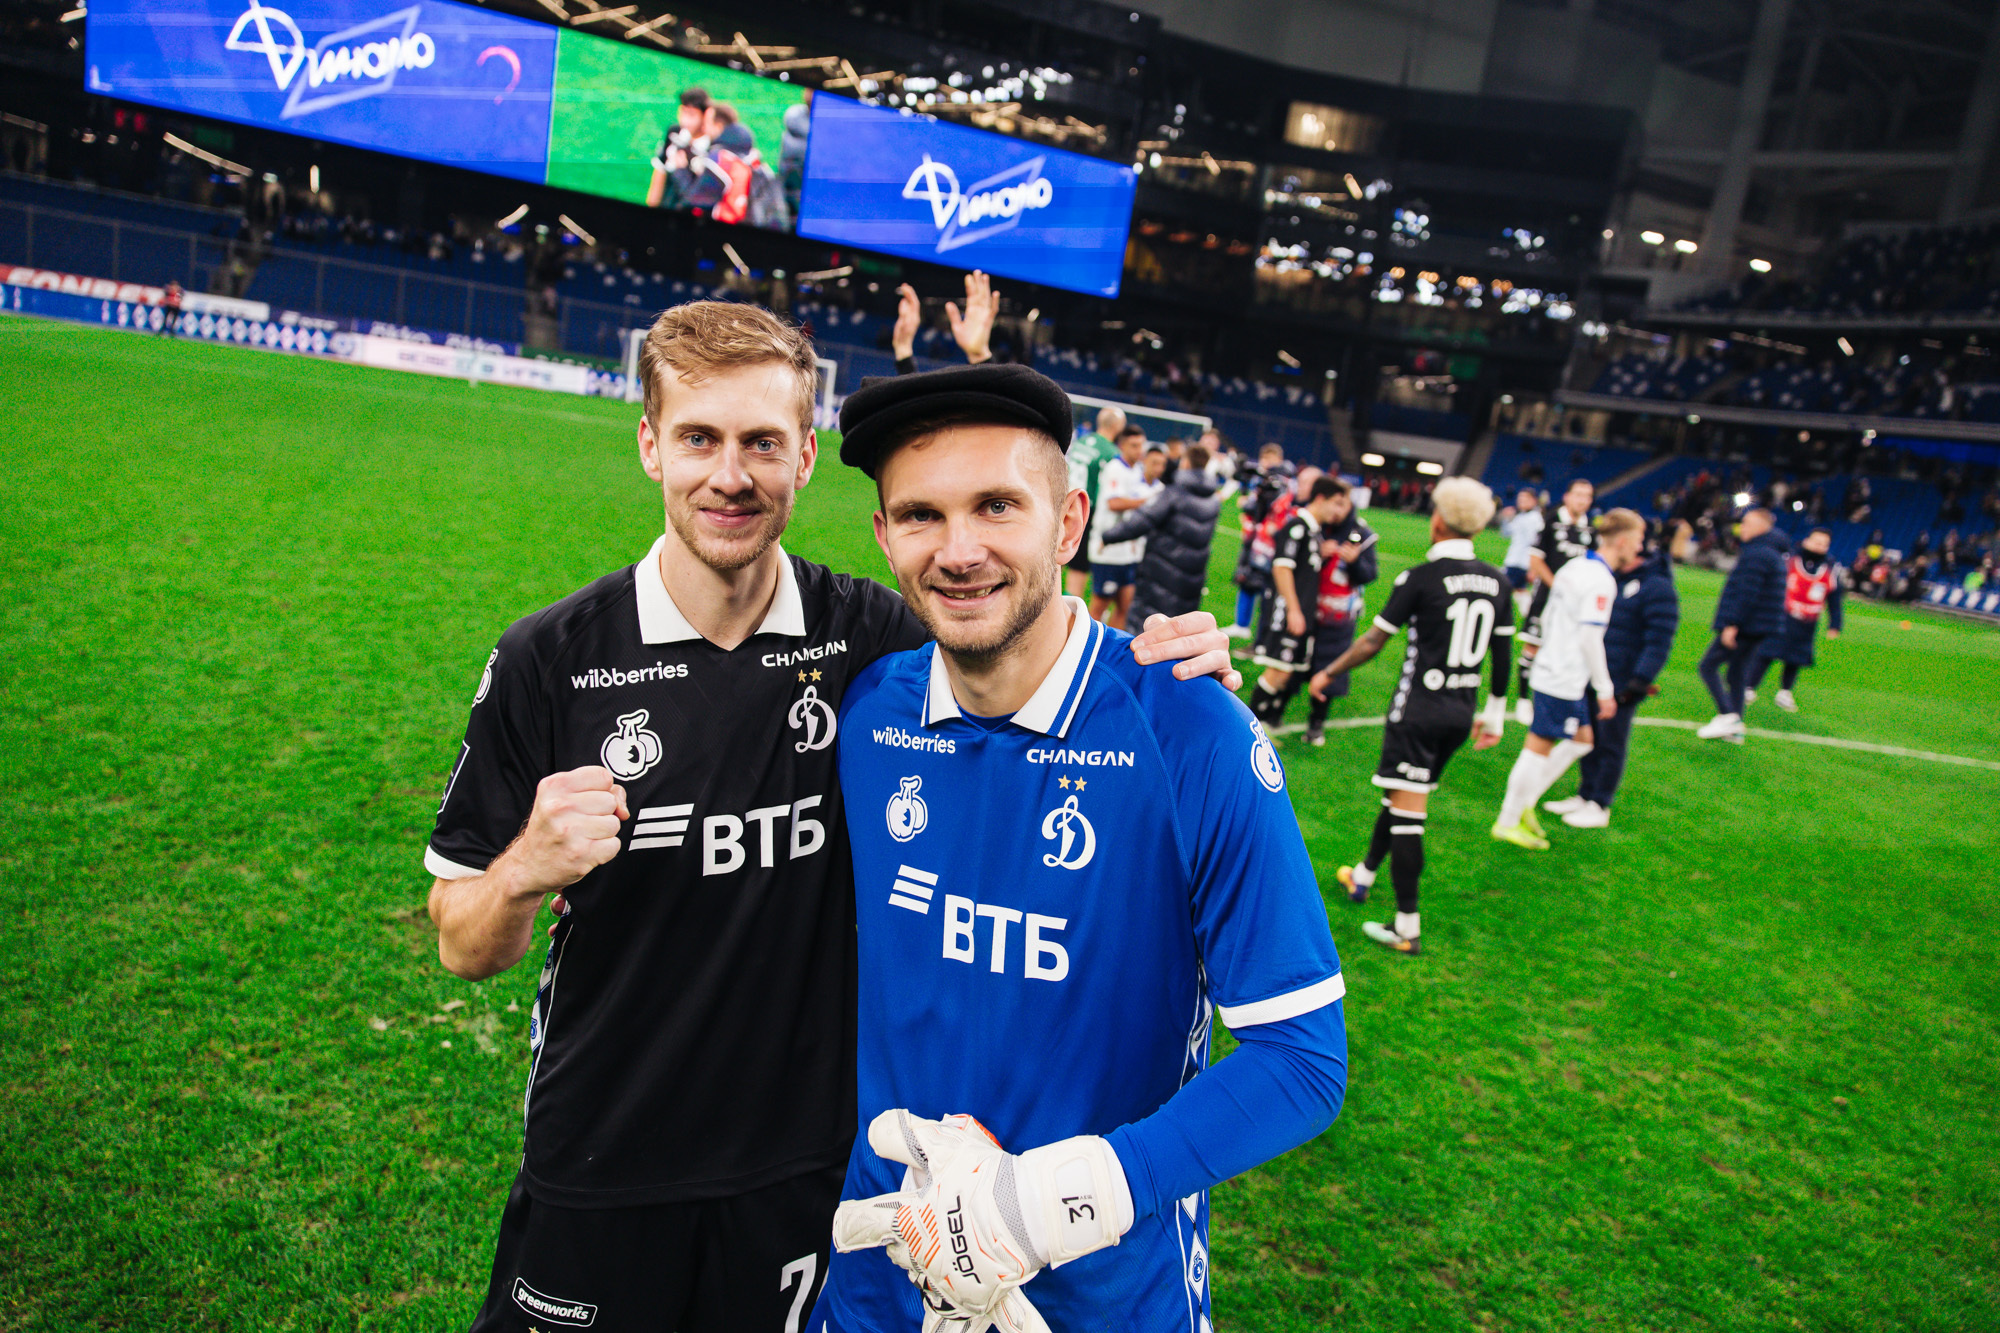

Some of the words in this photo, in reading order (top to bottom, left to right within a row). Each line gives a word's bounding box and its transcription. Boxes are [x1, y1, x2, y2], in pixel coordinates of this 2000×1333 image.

[1446, 598, 1495, 668] 10
[761, 640, 847, 667] CHANGAN
[571, 660, 689, 689] wildberries
[873, 726, 956, 754] wildberries
[1026, 748, 1135, 767] CHANGAN
[702, 795, 826, 877] ВТБ
[942, 893, 1070, 982] ВТБ
[1061, 1196, 1095, 1224] 31
[947, 1194, 981, 1284] JÖGEL
[517, 1287, 589, 1320] greenworks
[779, 1252, 818, 1333] 7
